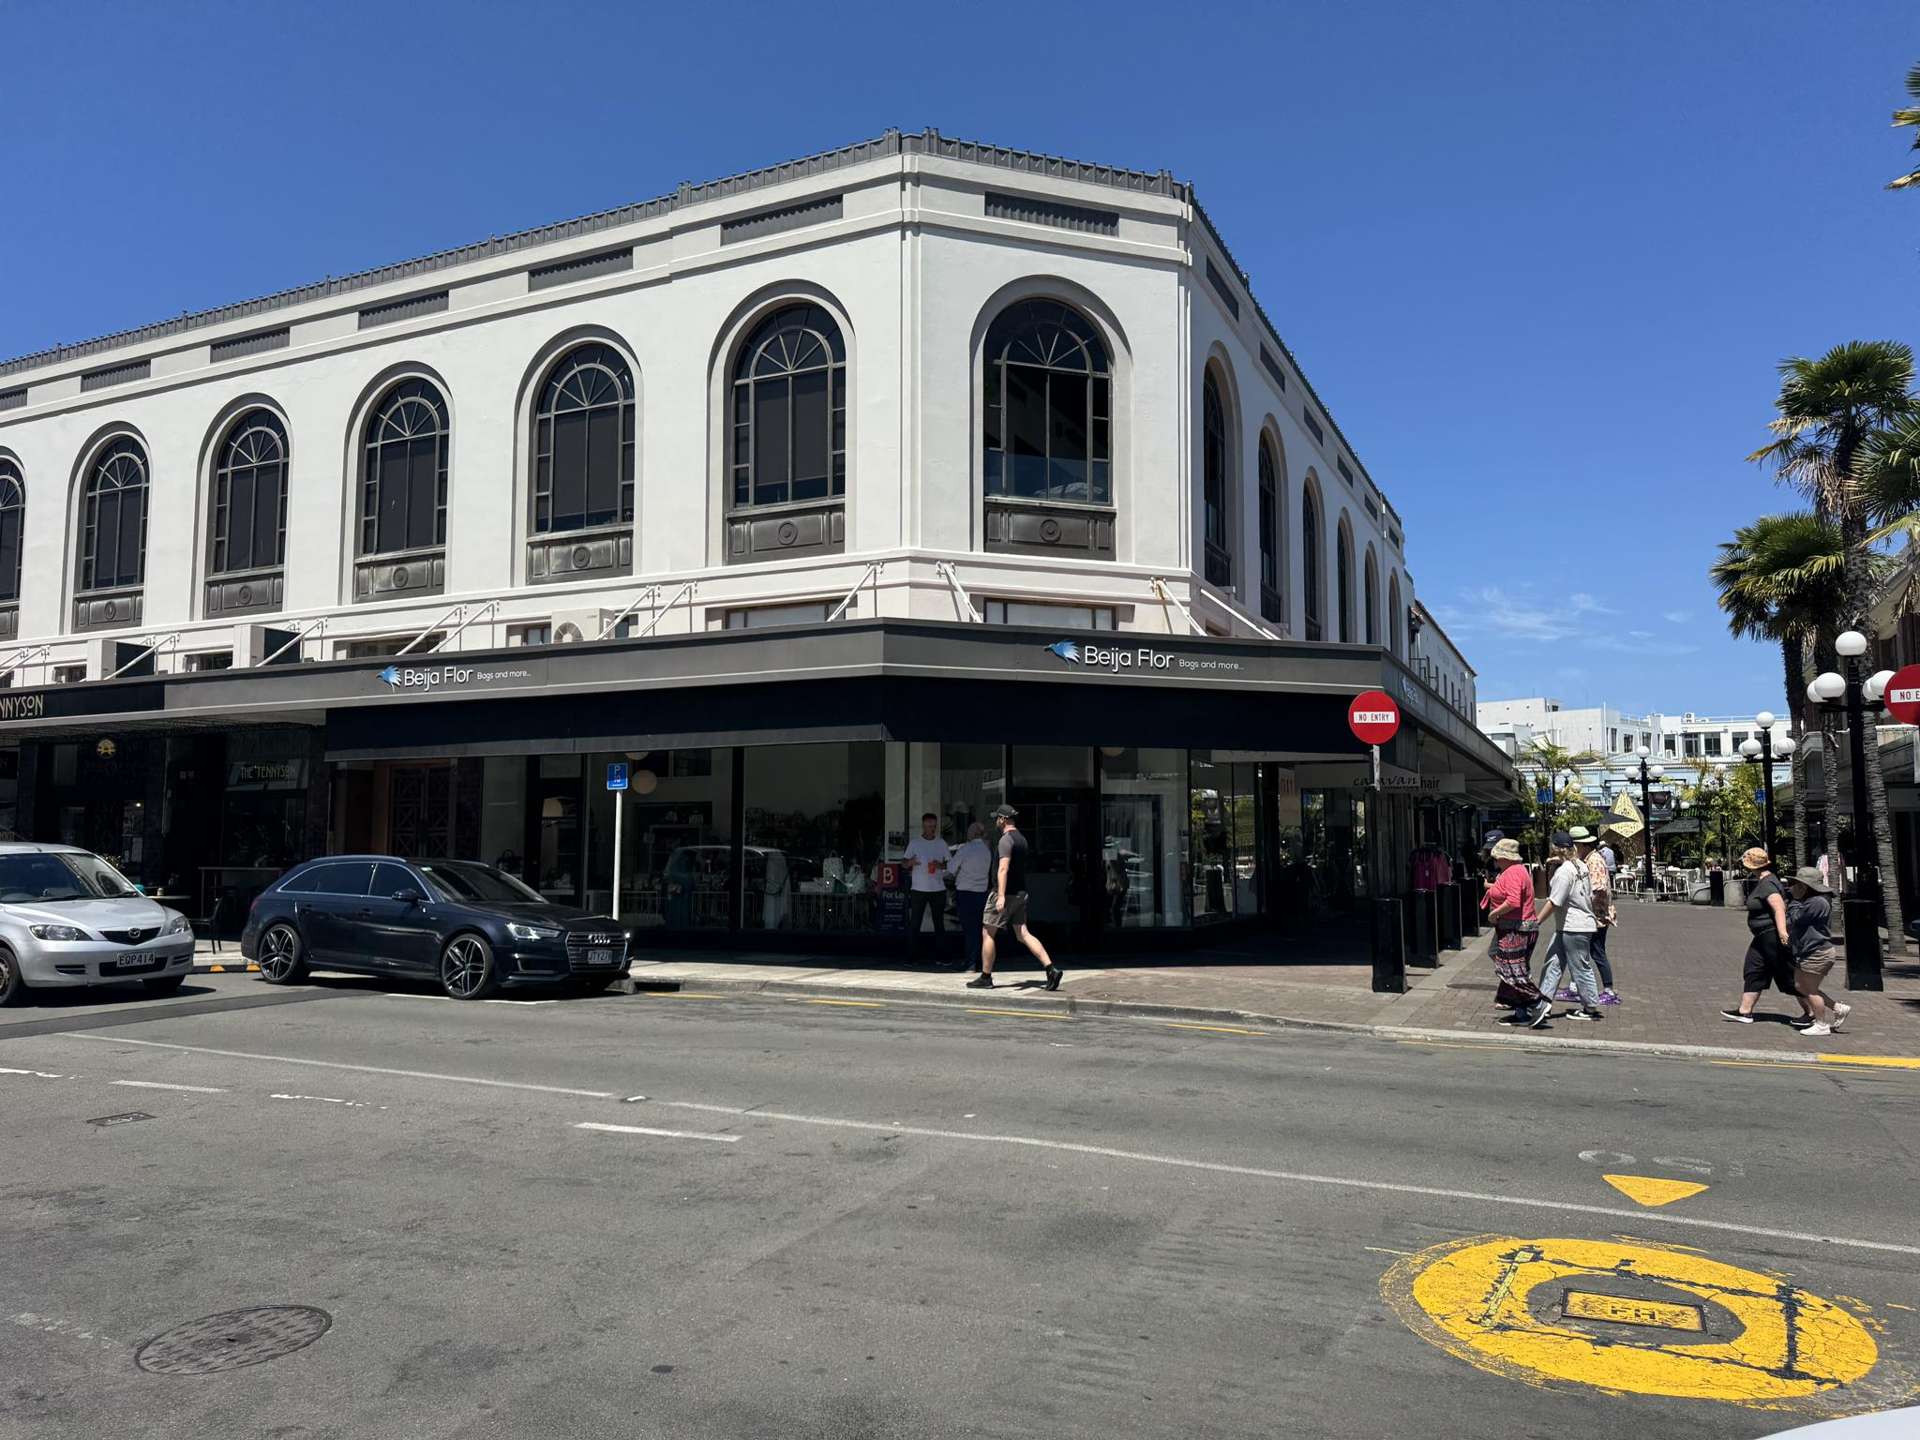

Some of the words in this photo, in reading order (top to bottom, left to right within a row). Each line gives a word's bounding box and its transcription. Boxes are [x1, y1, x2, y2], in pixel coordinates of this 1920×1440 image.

[1084, 645, 1132, 672] Beija
[1138, 649, 1175, 668] Flor
[1179, 659, 1199, 671] Bags
[1200, 660, 1216, 669] and
[404, 669, 439, 691] Beija
[444, 667, 473, 683] Flor
[477, 671, 494, 681] Bags
[495, 670, 508, 679] and
[1900, 691, 1911, 701] NO
[1358, 713, 1367, 722] NO
[1370, 713, 1389, 721] ENTRY
[1419, 776, 1440, 789] hair
[883, 867, 894, 884] B
